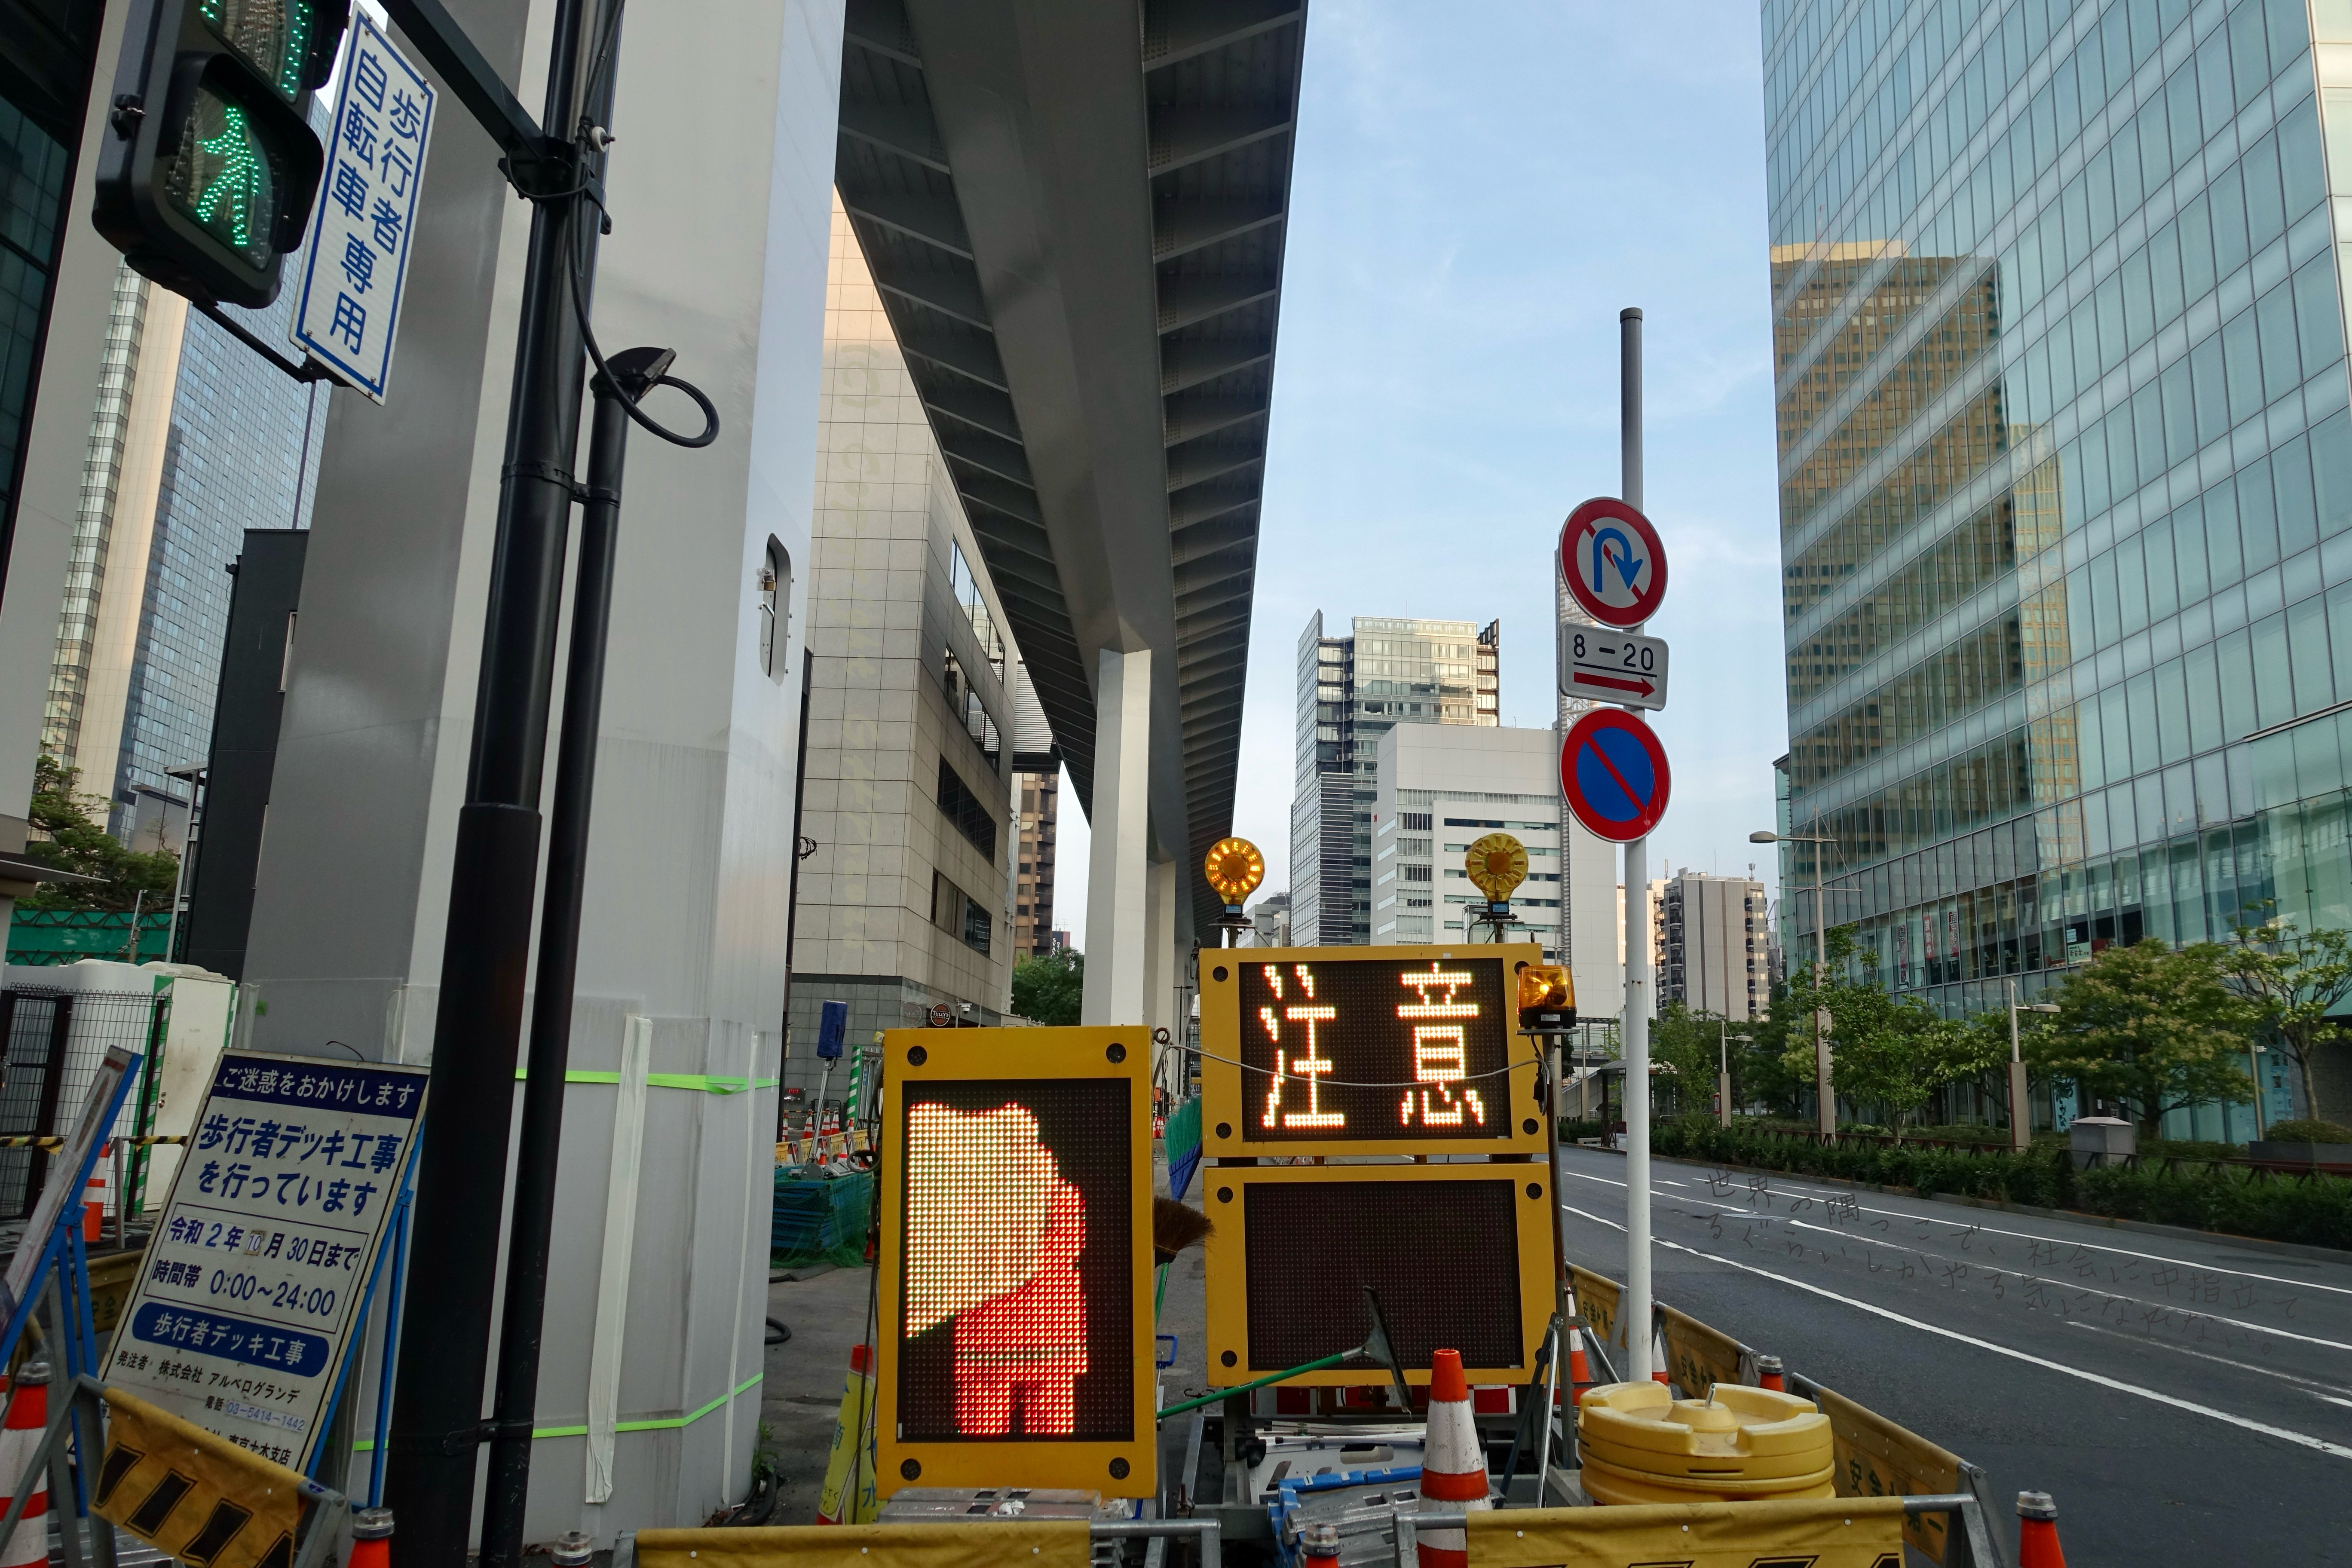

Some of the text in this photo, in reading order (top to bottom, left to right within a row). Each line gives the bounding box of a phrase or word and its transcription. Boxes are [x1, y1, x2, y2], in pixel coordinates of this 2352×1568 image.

[1260, 961, 1485, 1127] 注意
[223, 1067, 415, 1109] ご迷惑をおかけします
[198, 1113, 403, 1174] 歩行者デッキ工事
[198, 1160, 378, 1217] を行っています
[151, 1259, 202, 1289] 時間帯
[153, 1311, 307, 1366] 歩行者デッキ工事
[116, 1350, 300, 1404] 発注者 株式会社 アルベログランデ
[205, 1395, 224, 1412] 電話
